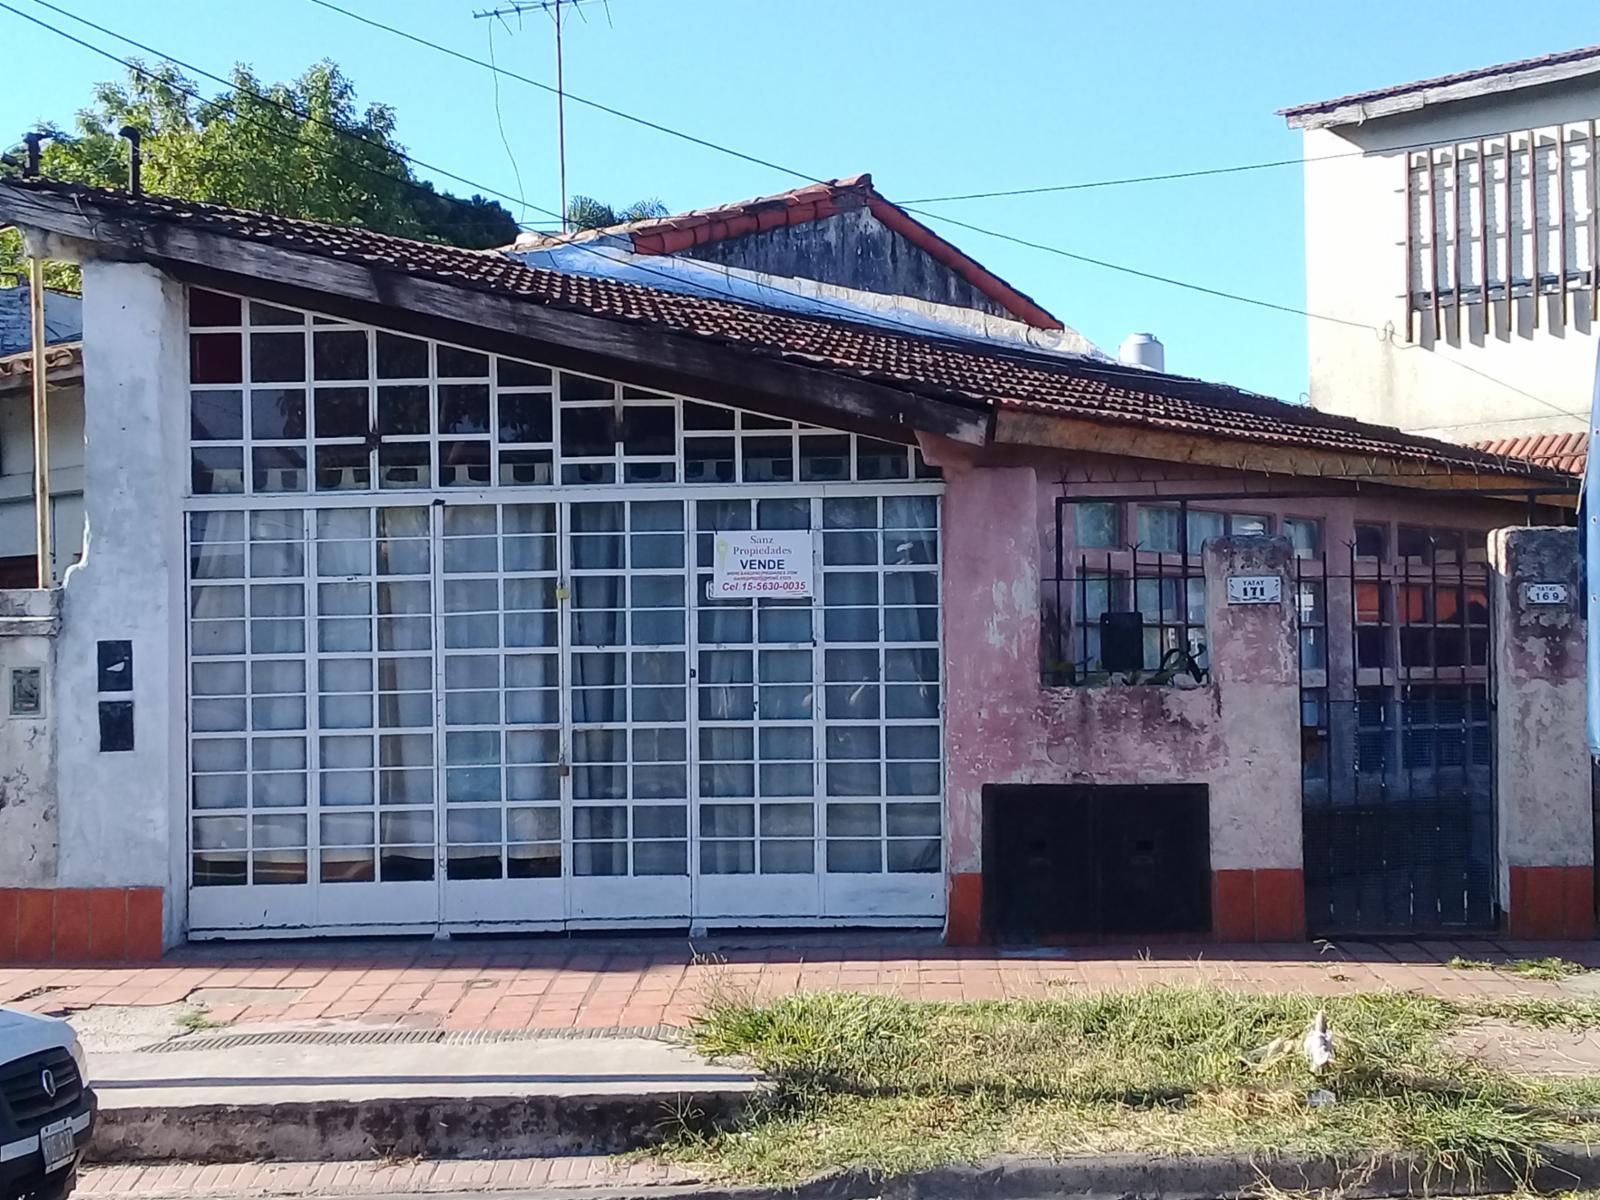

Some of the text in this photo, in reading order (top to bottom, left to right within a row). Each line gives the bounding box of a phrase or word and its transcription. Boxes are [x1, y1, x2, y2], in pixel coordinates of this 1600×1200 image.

[750, 535, 774, 544] Sanz
[733, 546, 793, 557] Propiedades
[740, 559, 785, 570] VENDE
[1243, 587, 1264, 597] 171
[1536, 592, 1559, 600] 169
